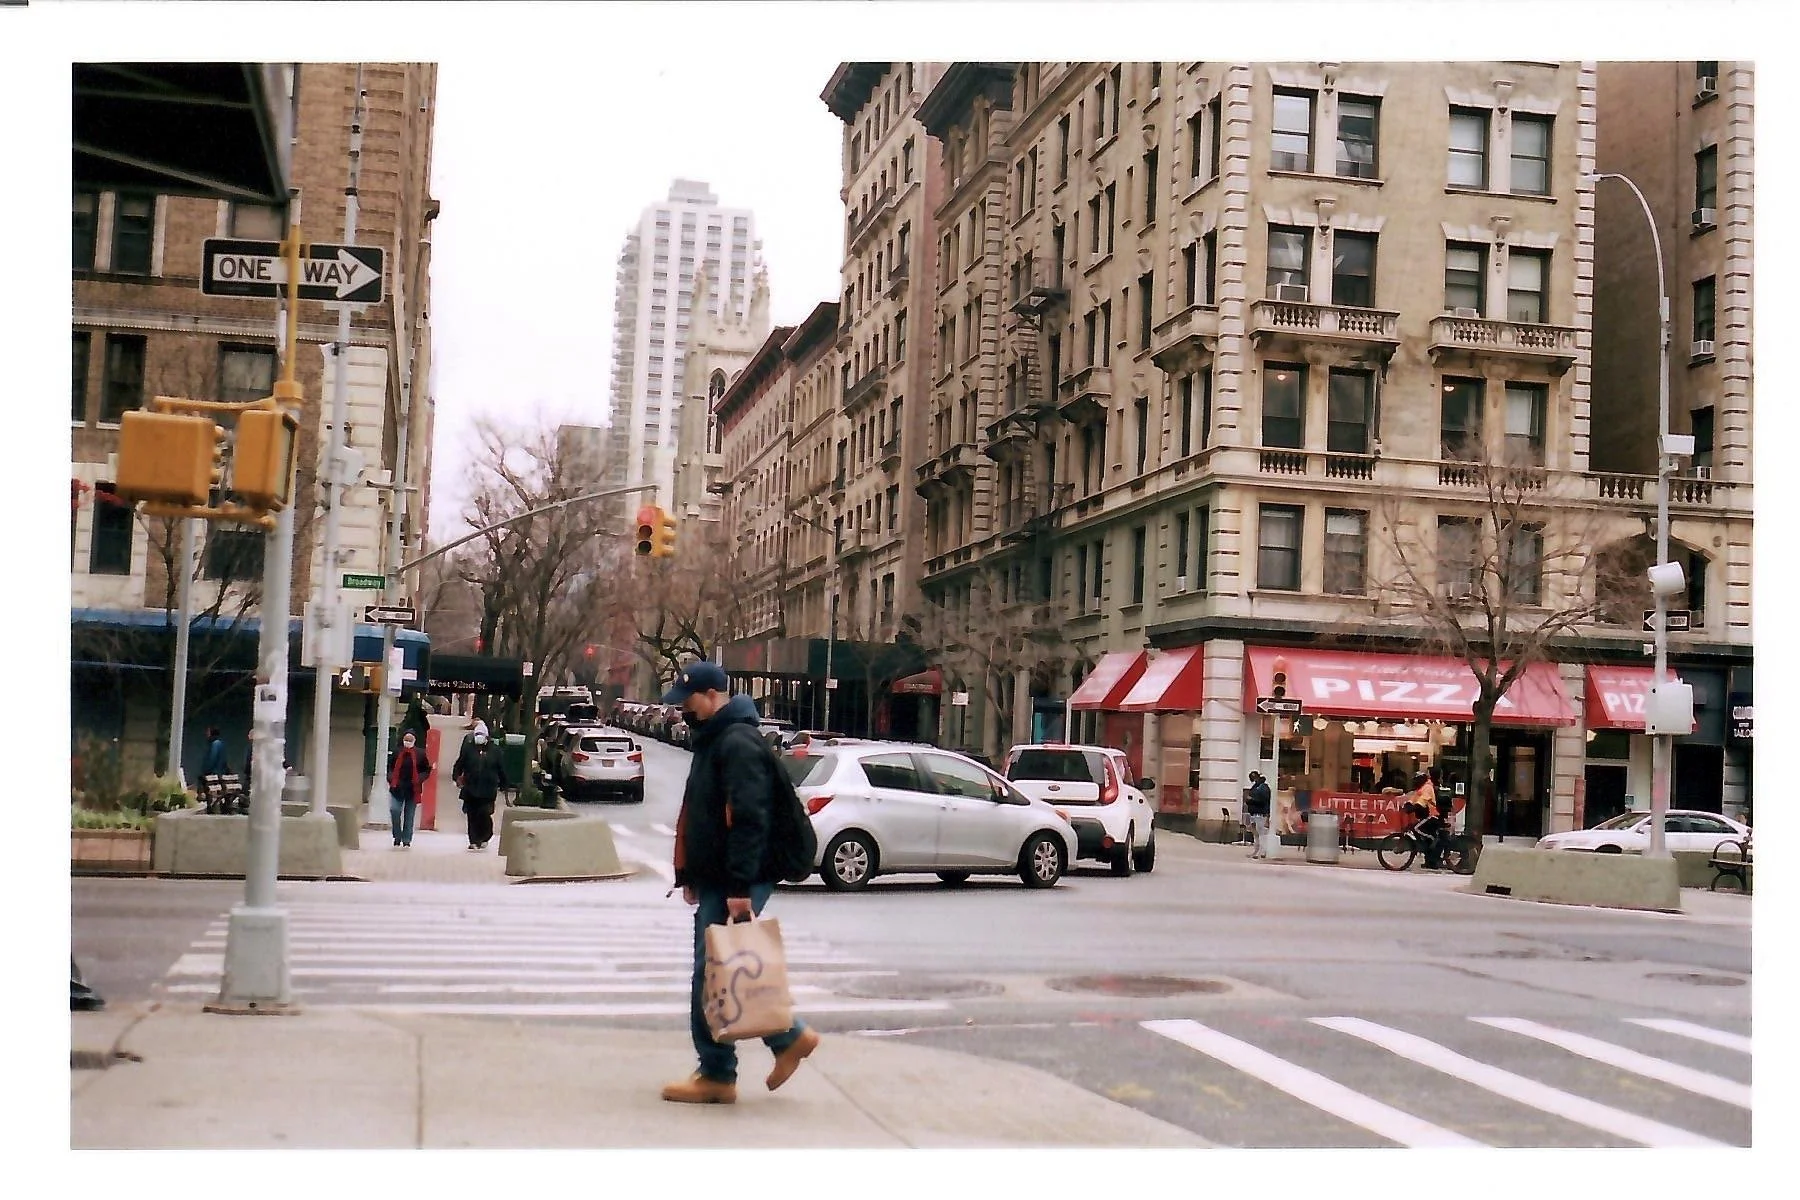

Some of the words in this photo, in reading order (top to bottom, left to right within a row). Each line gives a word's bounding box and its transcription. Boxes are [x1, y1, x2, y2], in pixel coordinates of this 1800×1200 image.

[219, 257, 272, 281] ONE
[303, 262, 359, 285] WAY
[347, 576, 381, 589] Broadway
[428, 680, 451, 688] West
[452, 680, 475, 689] 92nd
[1603, 692, 1646, 713] PIZ
[1319, 798, 1369, 811] LITTLE
